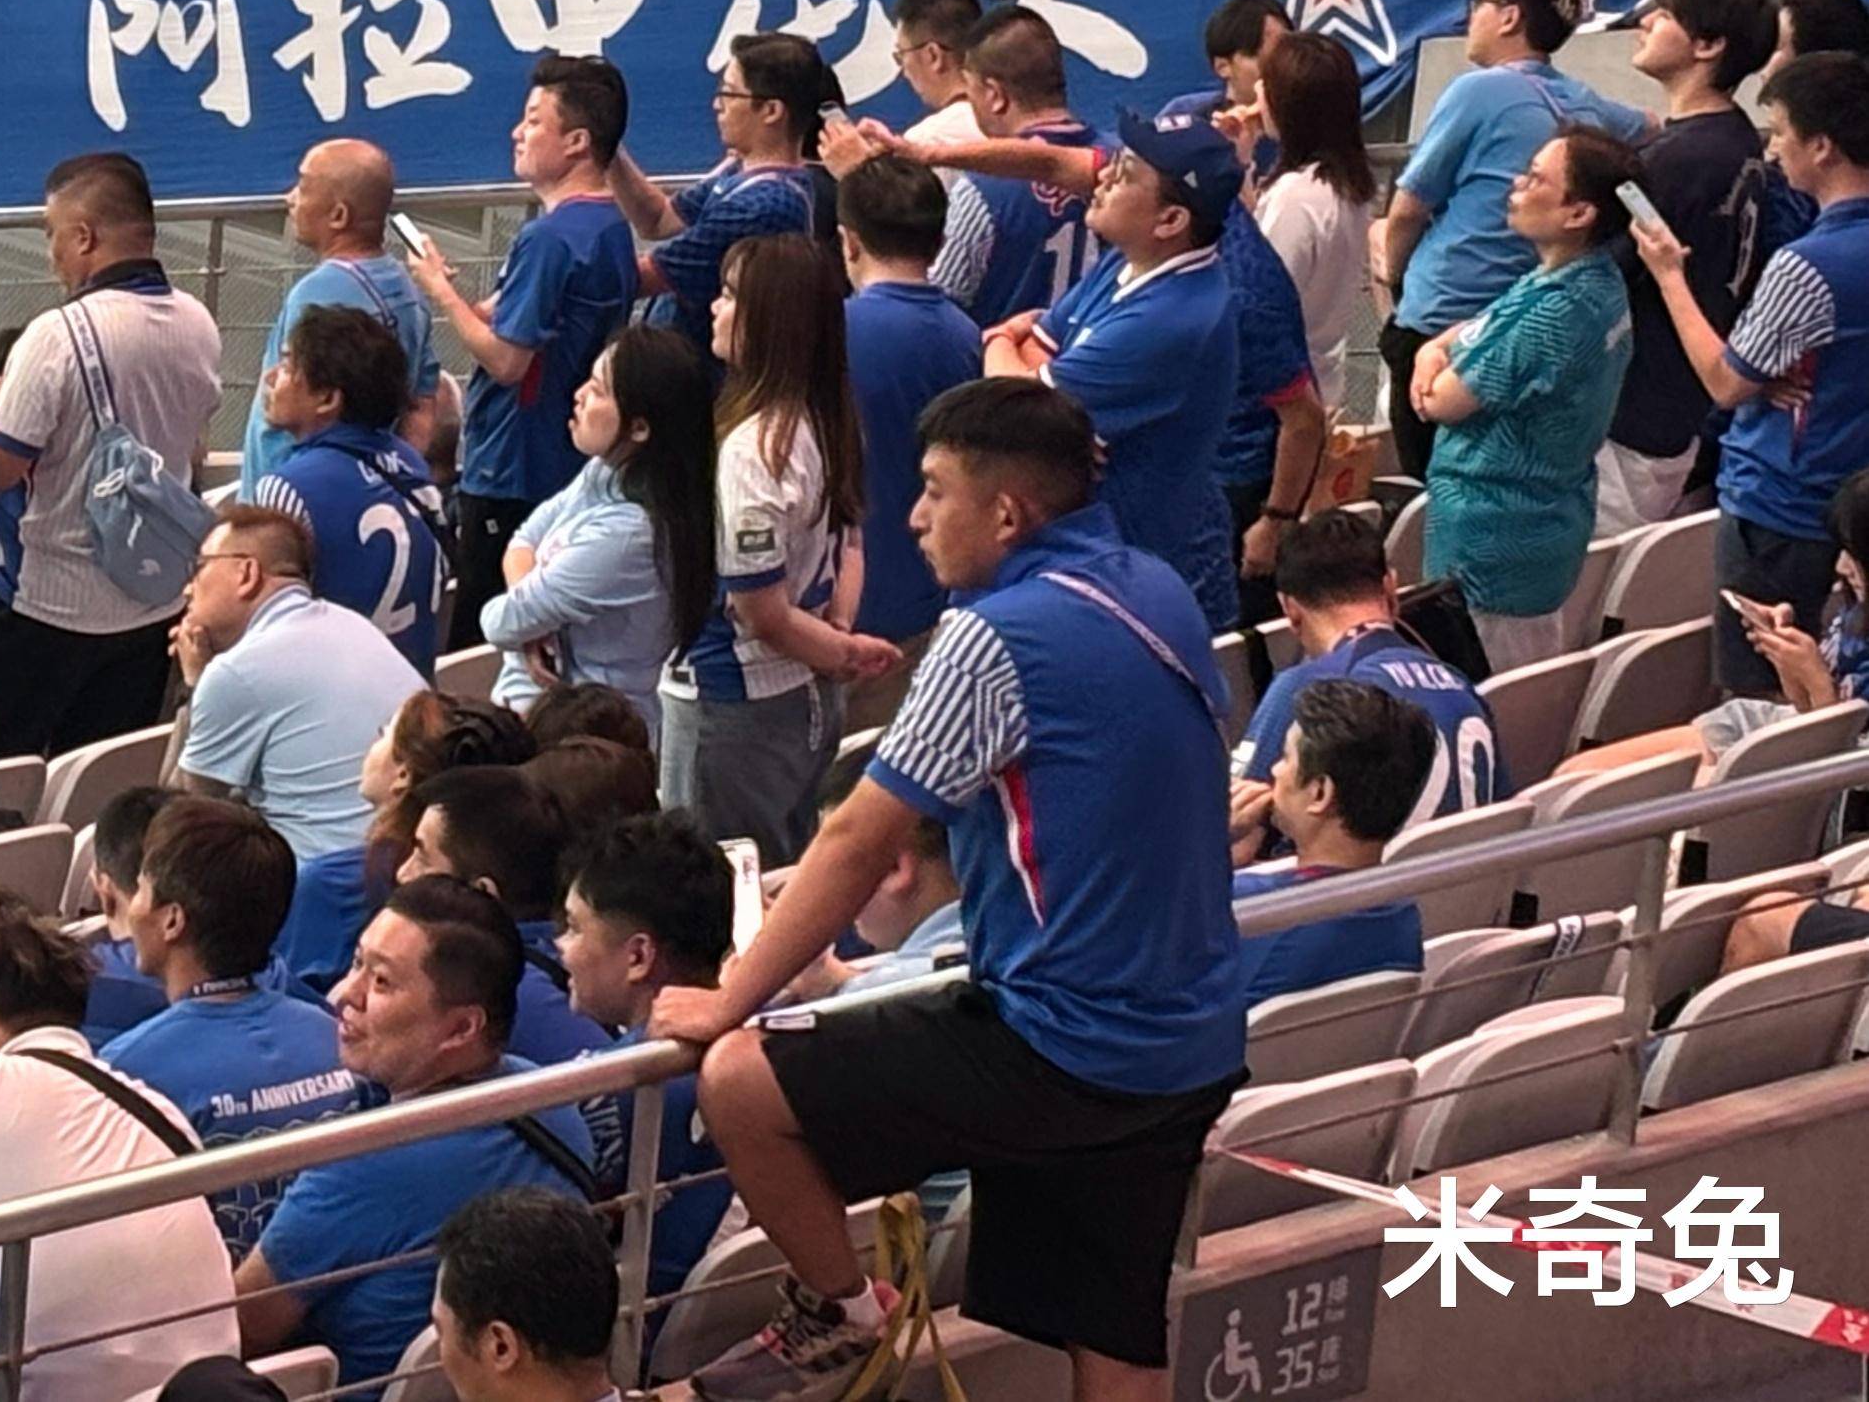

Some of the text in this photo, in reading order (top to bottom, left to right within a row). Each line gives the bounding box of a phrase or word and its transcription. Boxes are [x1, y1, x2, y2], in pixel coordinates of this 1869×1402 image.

[250, 1067, 356, 1113] ANNIVERSARY
[1280, 1283, 1324, 1336] 12
[1271, 1340, 1315, 1396] 35
